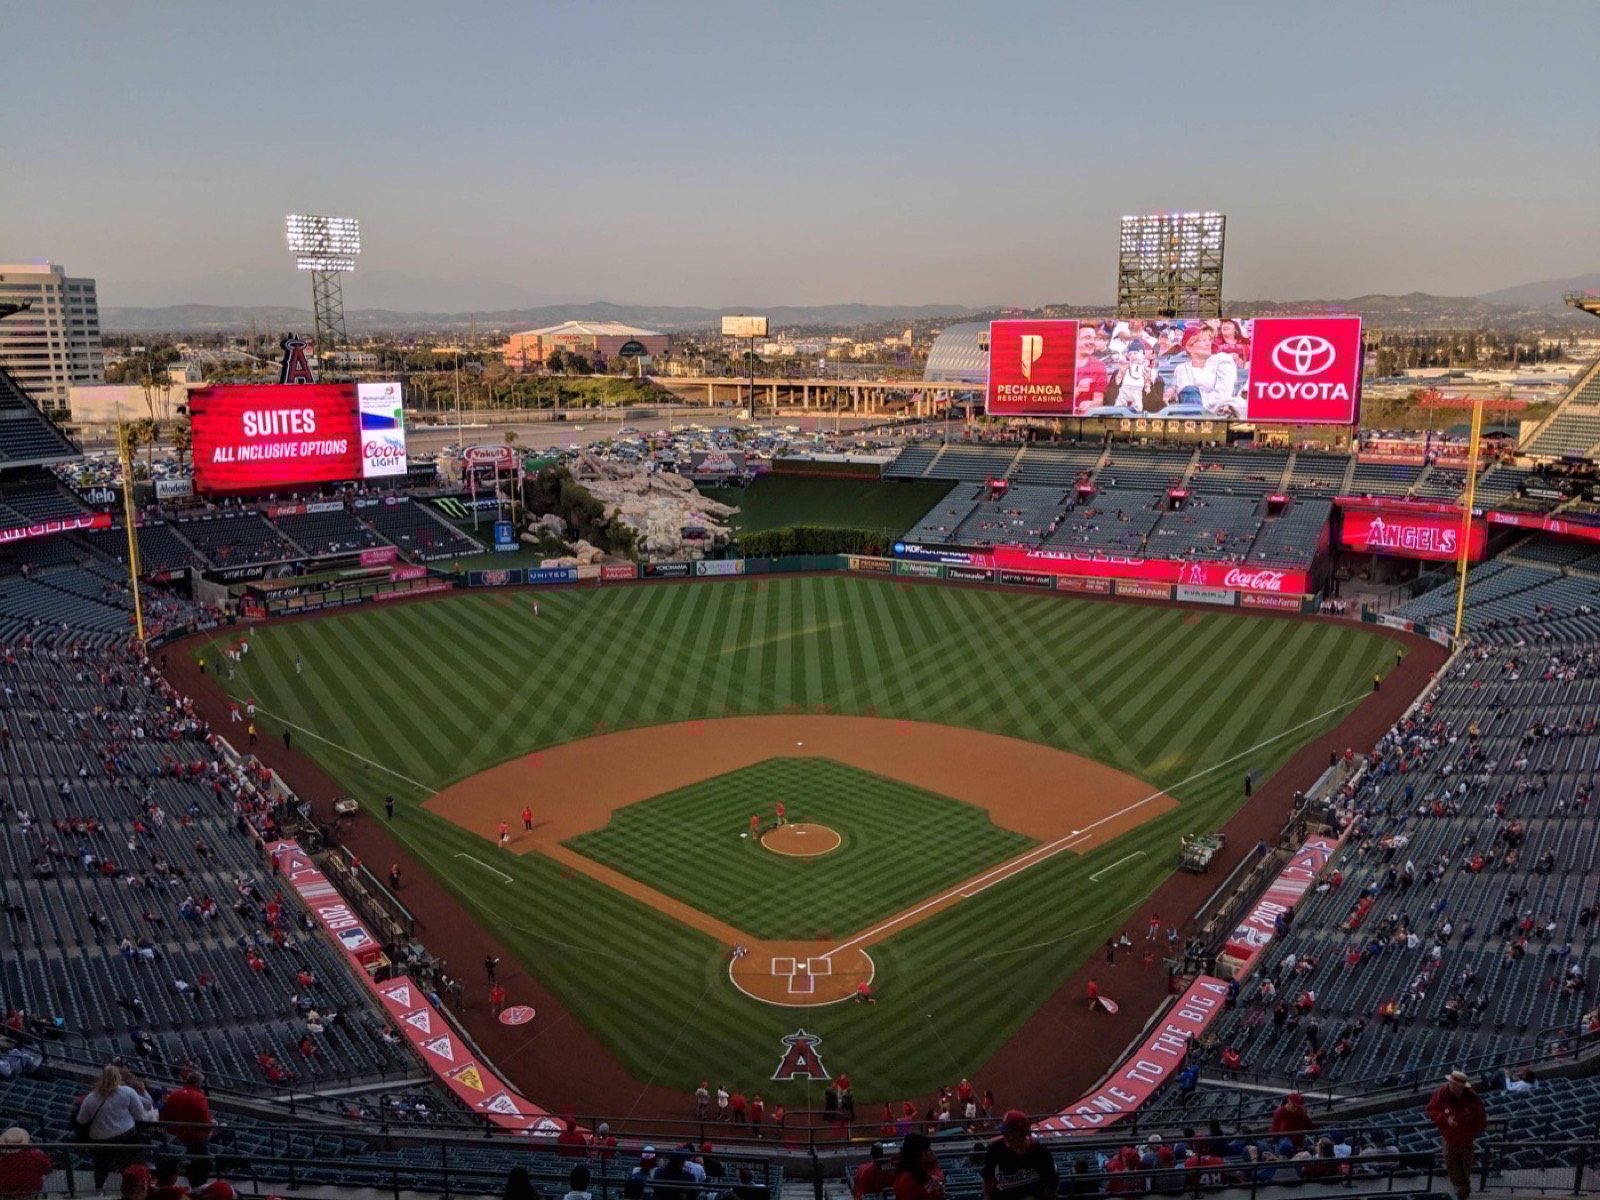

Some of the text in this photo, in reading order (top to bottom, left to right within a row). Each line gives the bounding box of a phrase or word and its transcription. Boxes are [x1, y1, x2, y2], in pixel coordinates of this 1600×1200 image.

[997, 385, 1062, 395] PECHANGA
[1254, 382, 1349, 400] TOYOTA
[242, 408, 316, 437] SUITES
[213, 439, 348, 463] ALL INCLUSIVE OPTIONS
[474, 450, 505, 458] Yakult
[371, 457, 400, 467] LIGHT
[82, 487, 116, 504] delo
[160, 481, 191, 494] Modelo
[1365, 516, 1456, 553] ANGELS
[530, 571, 566, 579] UNITED
[910, 563, 939, 573] National
[950, 569, 986, 580] Thermador
[1225, 568, 1286, 591] Coca-Cola
[1256, 596, 1299, 608] State Farm
[318, 904, 359, 929] 2019
[1249, 901, 1287, 928] 2019
[1126, 1060, 1164, 1084] TO
[1150, 1024, 1192, 1056] THE
[1178, 994, 1216, 1023] BIG
[1200, 982, 1227, 995] A
[769, 1028, 832, 1080] A
